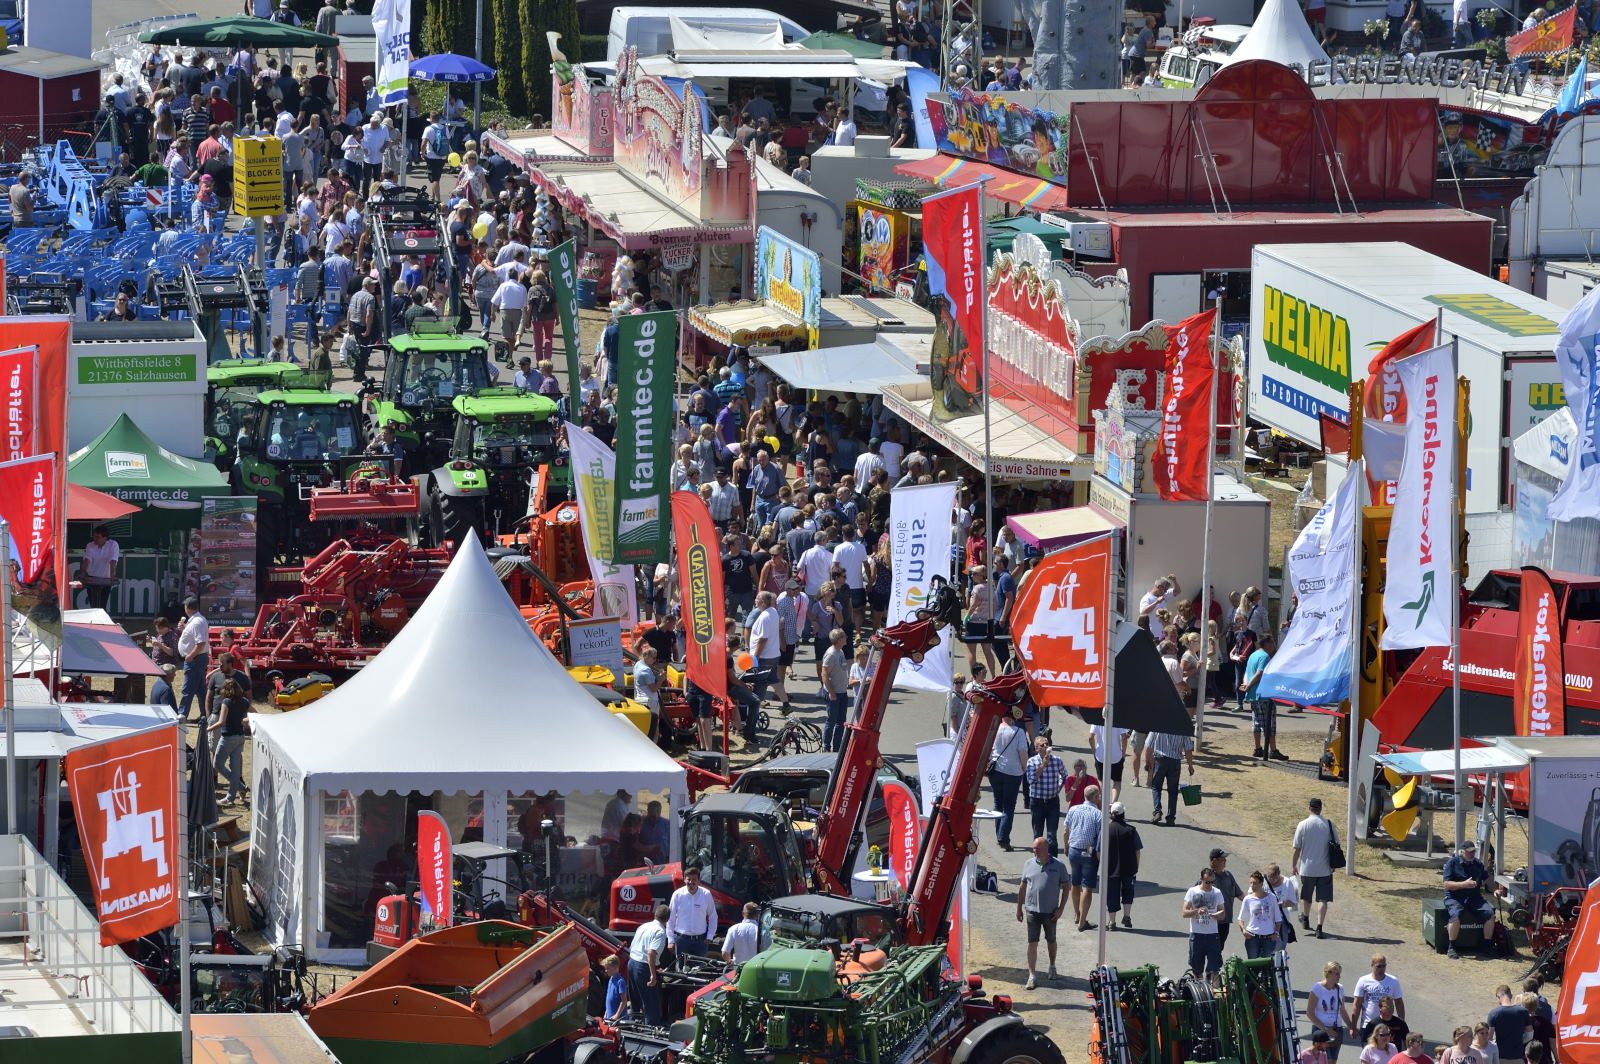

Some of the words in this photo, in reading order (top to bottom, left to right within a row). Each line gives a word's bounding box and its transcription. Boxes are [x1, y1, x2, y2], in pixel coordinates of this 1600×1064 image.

[600, 109, 609, 135] EIS
[247, 169, 273, 178] BLOCK
[248, 195, 281, 204] Marktplatz
[666, 256, 690, 266] WATTE
[1263, 284, 1351, 386] HELMA
[93, 357, 172, 369] Witthöftsfelde
[174, 356, 182, 367] 8
[88, 371, 123, 382] 21376
[126, 370, 187, 381] Salzhausen
[404, 393, 413, 403] 50
[629, 319, 657, 492] farmtec.de
[269, 444, 278, 455] 40
[109, 458, 145, 469] farmtec
[1005, 463, 1023, 474] wie
[1026, 464, 1058, 476] Sahne
[622, 504, 657, 523] farmtec
[583, 627, 609, 639] Welt-
[579, 636, 613, 651] rekord!
[1565, 673, 1593, 689] OVADO
[1546, 771, 1588, 780] Zuverlässig
[838, 765, 858, 818] Schäffer
[924, 844, 946, 900] Schäffer
[623, 888, 634, 900] 20
[379, 907, 387, 919] 20
[193, 1000, 204, 1011] 20
